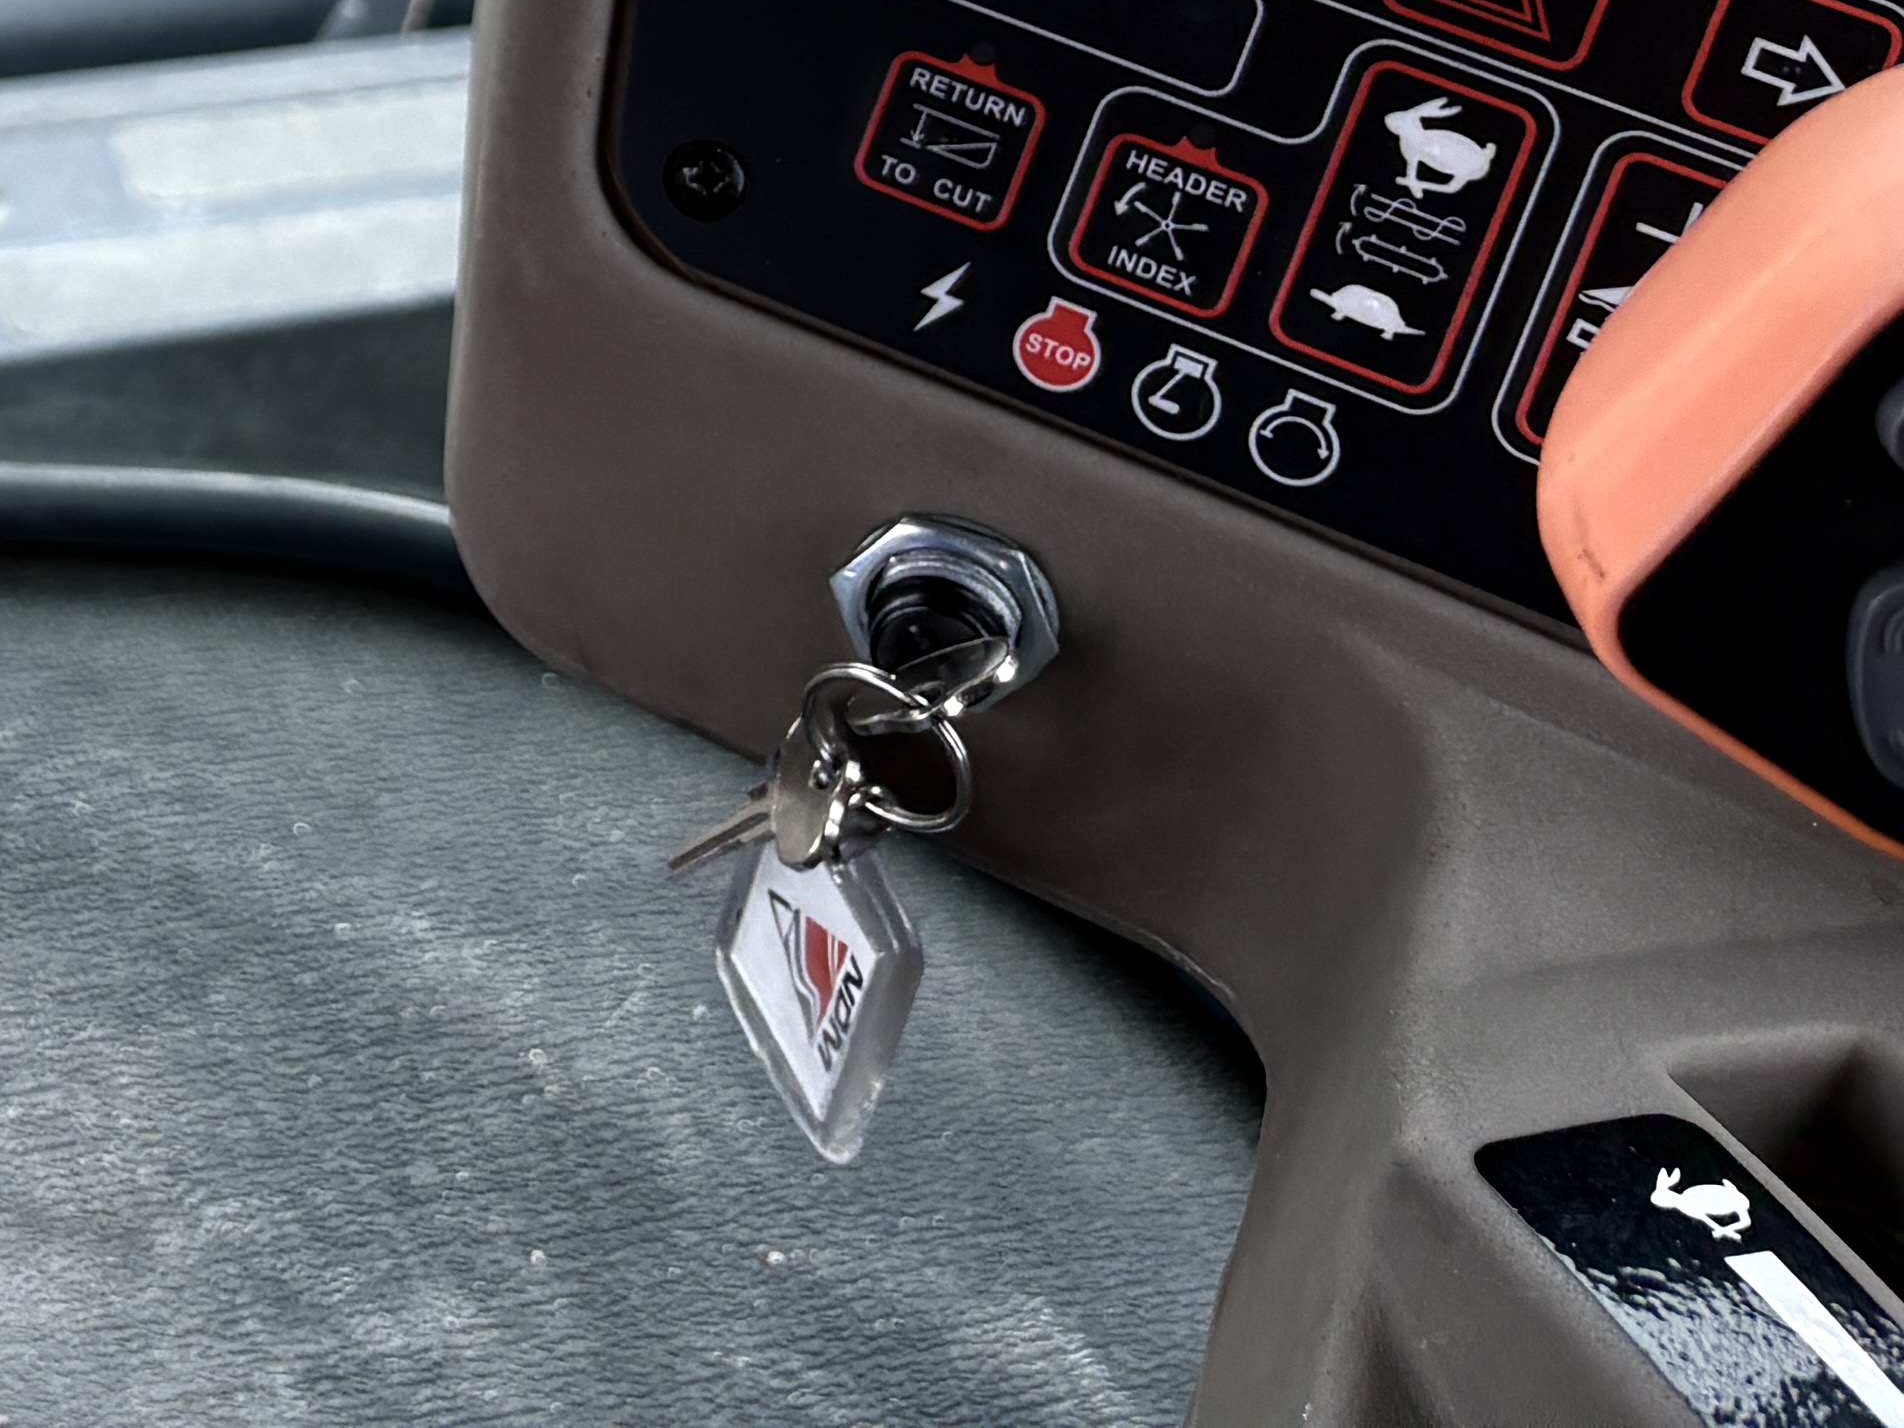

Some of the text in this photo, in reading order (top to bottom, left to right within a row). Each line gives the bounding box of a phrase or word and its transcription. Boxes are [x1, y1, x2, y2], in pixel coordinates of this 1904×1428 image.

[909, 66, 1027, 130] RETURN
[879, 152, 993, 217] TO CUT
[1124, 148, 1249, 215] HEADER
[1107, 243, 1198, 298] INDEX
[1024, 327, 1093, 375] STOP
